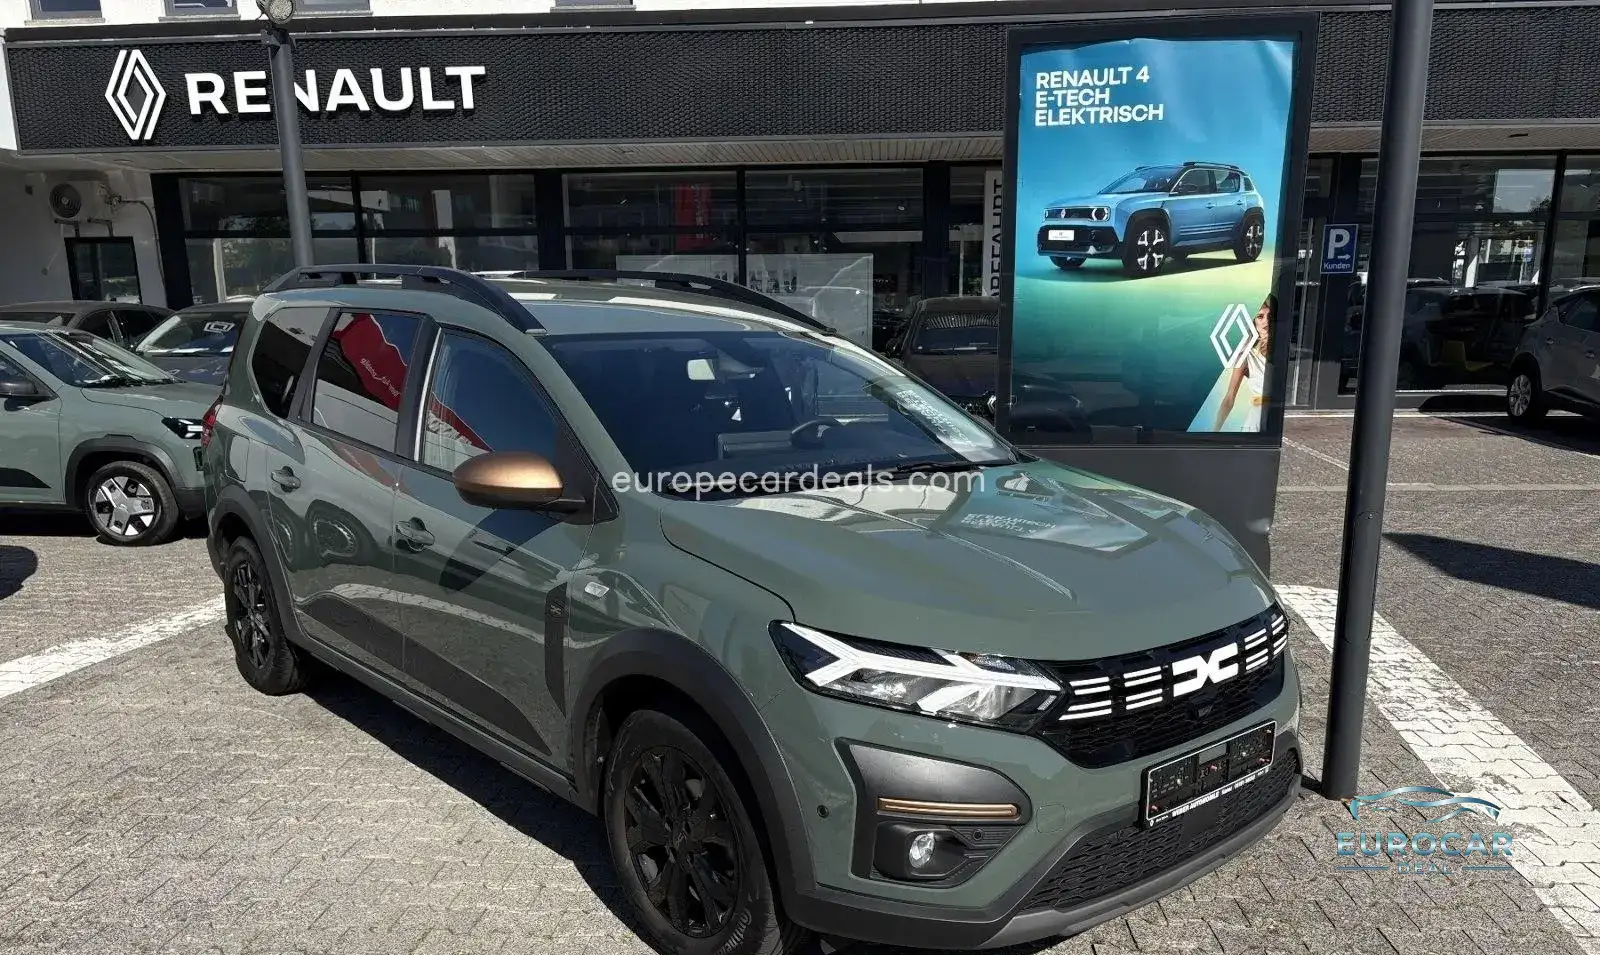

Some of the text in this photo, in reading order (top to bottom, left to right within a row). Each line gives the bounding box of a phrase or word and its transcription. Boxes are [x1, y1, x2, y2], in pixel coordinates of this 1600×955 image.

[1036, 65, 1151, 89] RENAULT 4
[184, 65, 487, 115] RENAULT
[1035, 87, 1111, 108] E-TECH
[1034, 103, 1164, 127] ELEKTRISCH
[1327, 228, 1351, 260] P
[1323, 261, 1351, 270] Kunden
